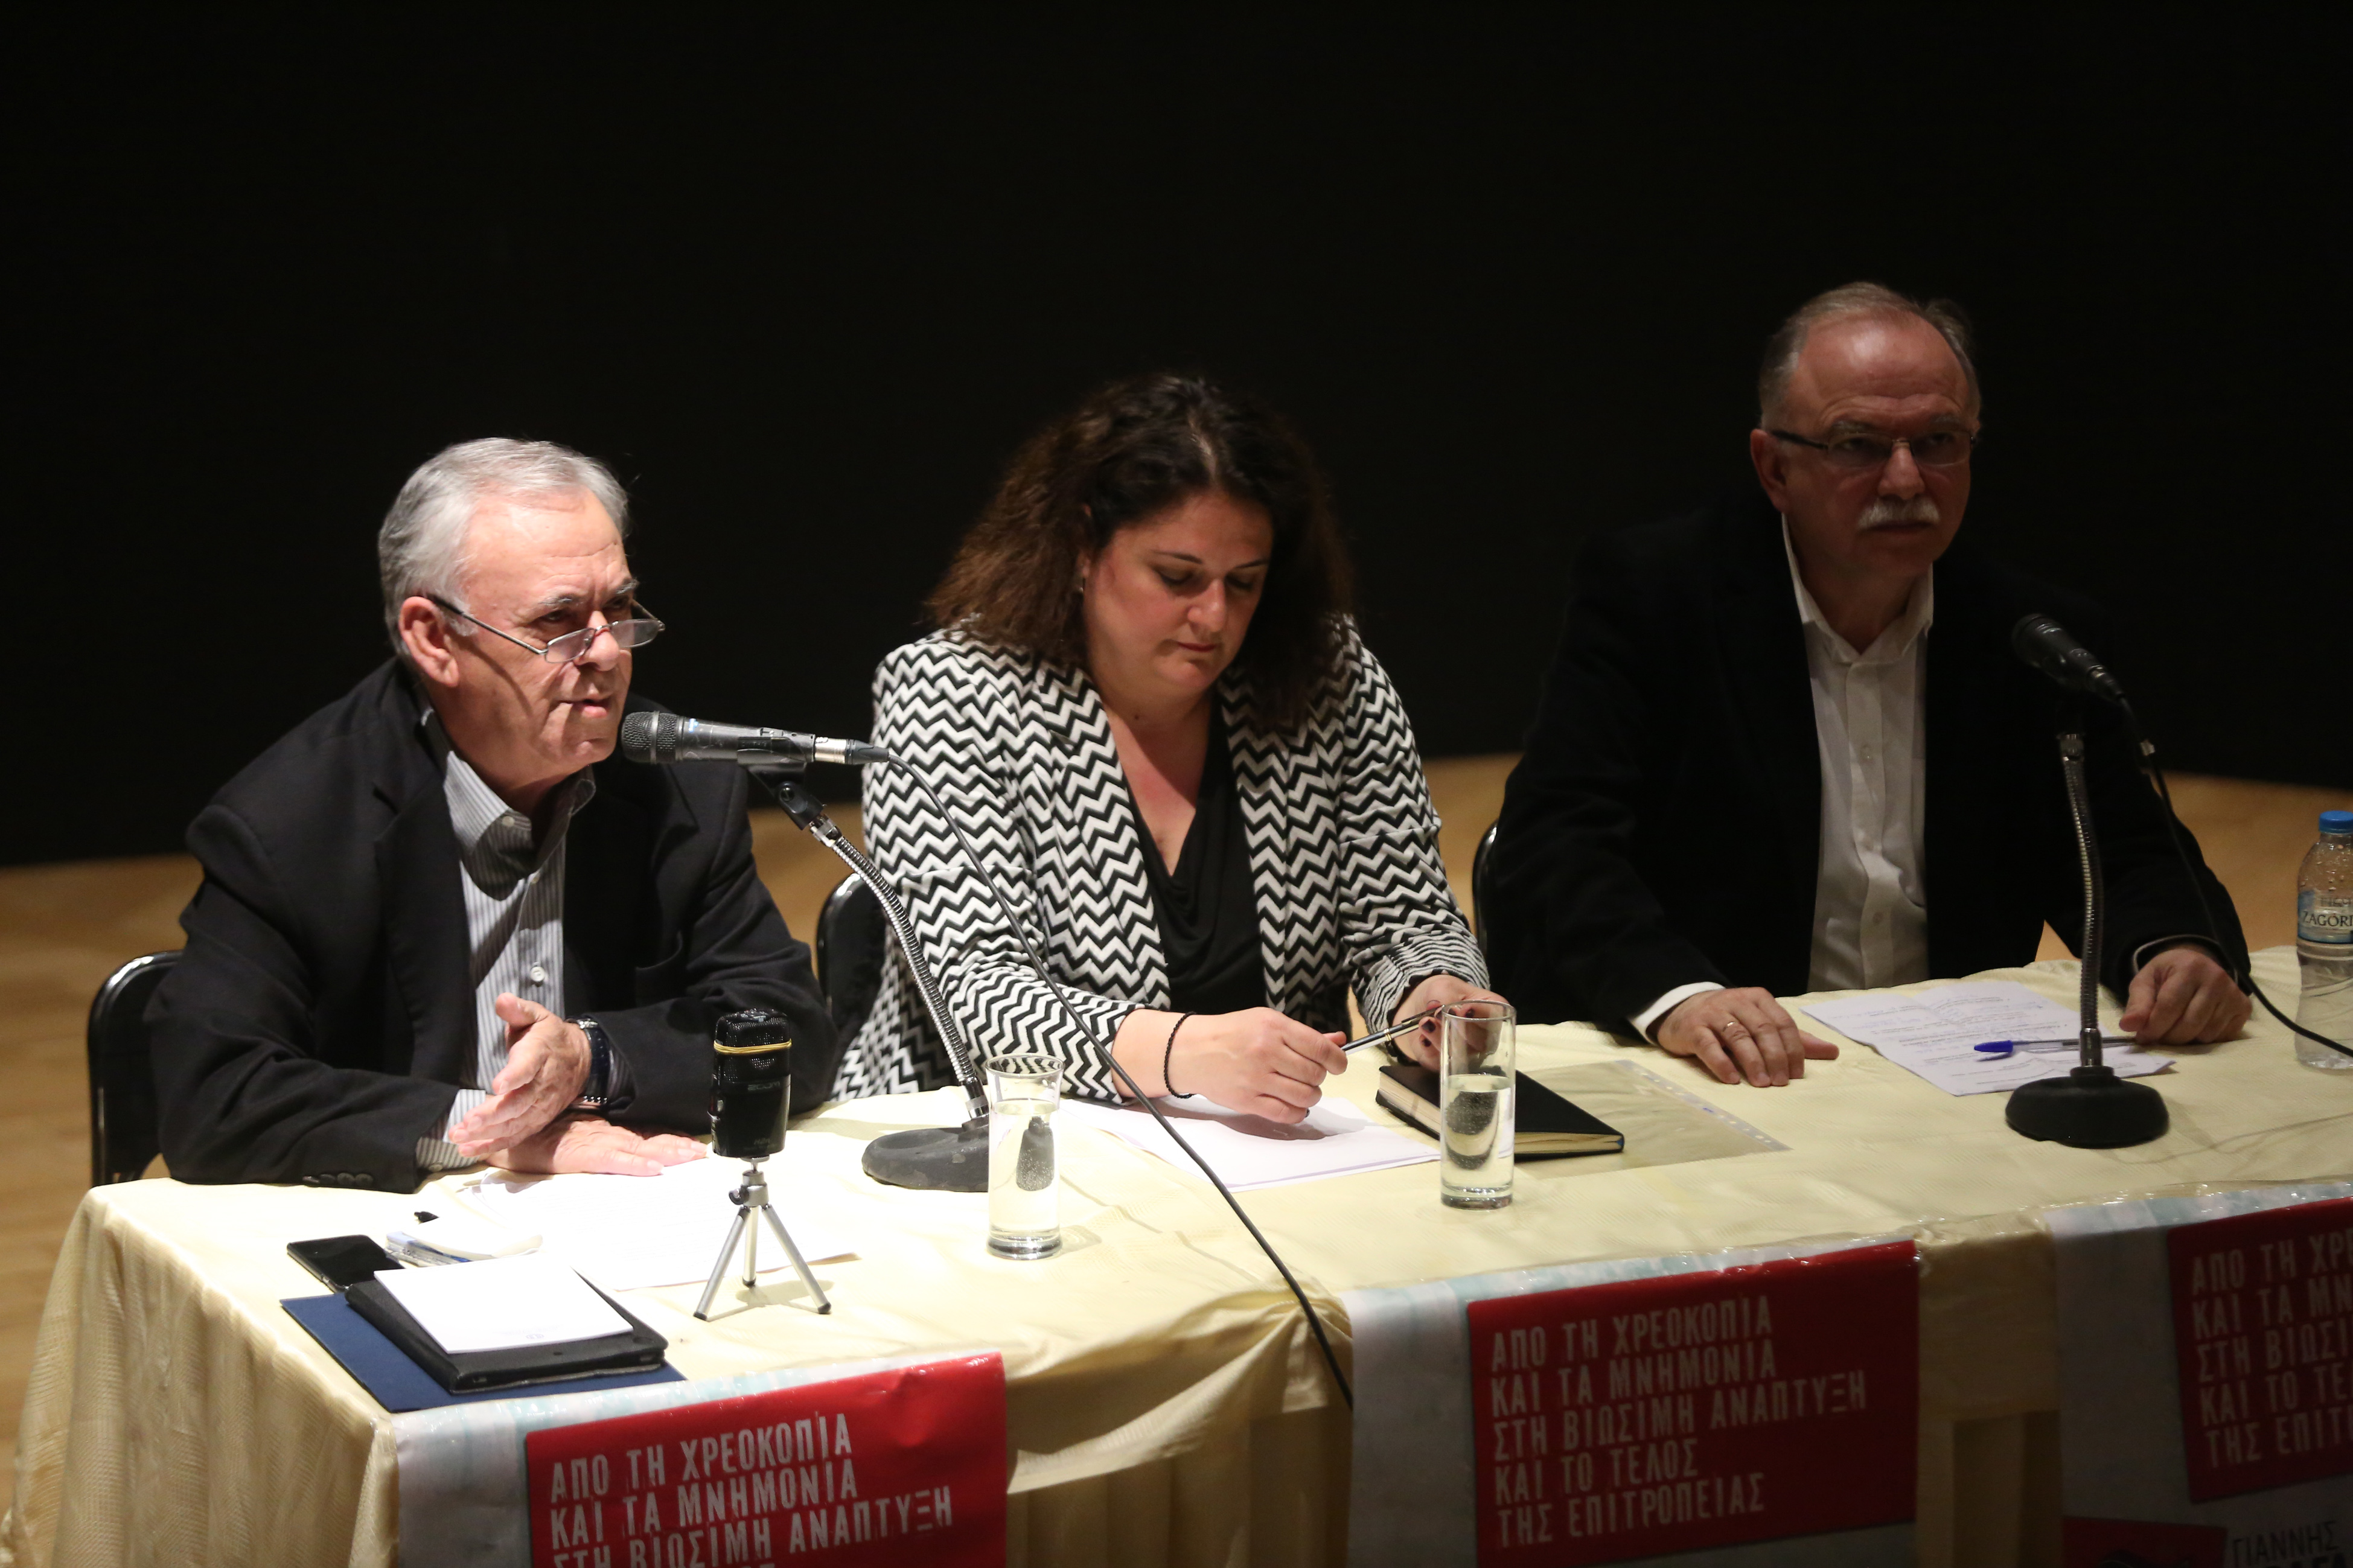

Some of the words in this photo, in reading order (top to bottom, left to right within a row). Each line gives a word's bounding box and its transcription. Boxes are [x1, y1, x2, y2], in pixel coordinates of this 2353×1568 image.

[2192, 1249, 2244, 1296] ΑΠΟ
[2260, 1240, 2294, 1283] ΤΗ
[1492, 1328, 1546, 1372] ΑΠΟ
[1563, 1319, 1598, 1362] ΤΗ
[1613, 1295, 1772, 1356] ΧΡΕΟΚΟΠΙΑ
[2192, 1293, 2240, 1339] ΚΑΙ
[2257, 1285, 2293, 1324] ΤΑ
[1490, 1371, 1540, 1417] ΚΑΙ
[1557, 1366, 1594, 1407] ΤΑ
[1609, 1339, 1777, 1400] ΜΝΗΜΟΝΙΑ
[2196, 1336, 2251, 1383] ΣΤΗ
[2200, 1380, 2249, 1426] ΚΑΙ
[2266, 1371, 2298, 1412] ΤΟ
[2314, 1361, 2353, 1404] ΤΕ
[1493, 1417, 1547, 1461] ΣΤΗ
[1563, 1393, 1694, 1451] ΒΙΩΣΙΜΗ
[1710, 1370, 1866, 1430] ΑΝΑΠΤΥΞΗ
[2206, 1421, 2261, 1468] ΤΗΣ
[2275, 1406, 2353, 1456] ΕΠΙΤ
[550, 1455, 609, 1503] ΑΠΟ
[626, 1444, 666, 1490] ΤΗ
[680, 1412, 852, 1480] ΧΡΕΟΚΟΠΙΑ
[1495, 1461, 1543, 1506] ΚΑΙ
[1562, 1455, 1594, 1495] ΤΟ
[1612, 1439, 1699, 1488] ΤΕΛΟΣ
[550, 1500, 603, 1550] ΚΑΙ
[622, 1494, 660, 1537] ΤΑ
[677, 1459, 857, 1528] ΜΝΗΜΟΝΙΑ
[628, 1517, 771, 1568] ΒΙΩΣΙΜΗ
[790, 1486, 953, 1554] ΑΝΑΠΤΥΞΗ
[1498, 1504, 1553, 1549] ΤΗΣ
[1569, 1473, 1764, 1538] ΕΠΙΤΡΟΠΕΙΑΣ
